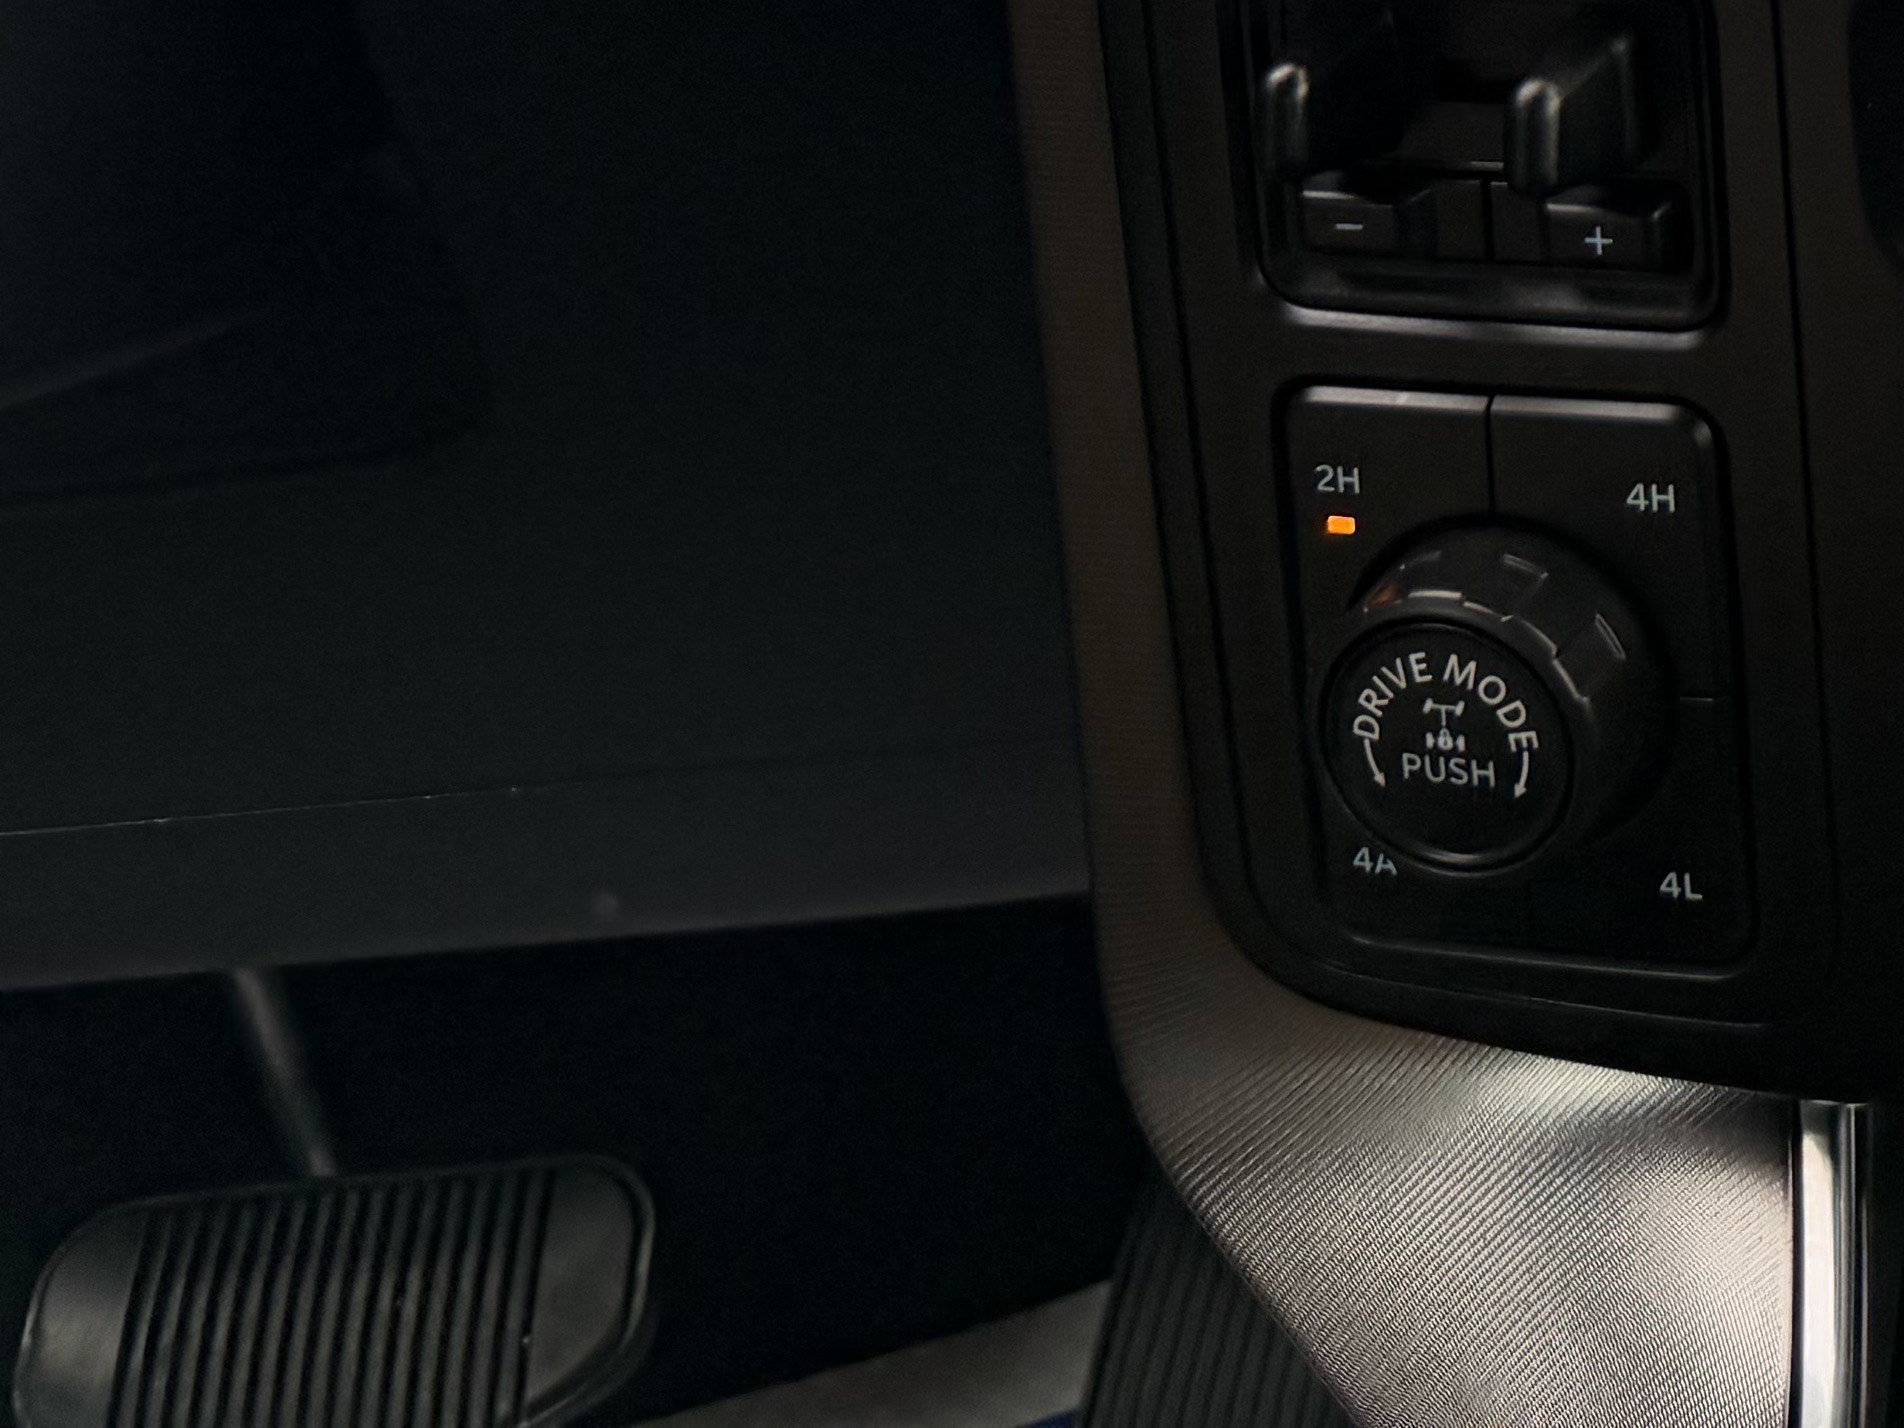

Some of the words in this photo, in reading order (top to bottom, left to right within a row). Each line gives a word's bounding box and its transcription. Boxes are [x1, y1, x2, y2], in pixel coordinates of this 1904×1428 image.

[1314, 464, 1360, 495] 2H
[1626, 483, 1676, 514] 4H
[1352, 651, 1433, 743] DRIVE
[1443, 654, 1540, 753] MODE
[1401, 752, 1496, 788] PUSH
[1352, 847, 1398, 876] 4A
[1659, 871, 1703, 901] 4L
